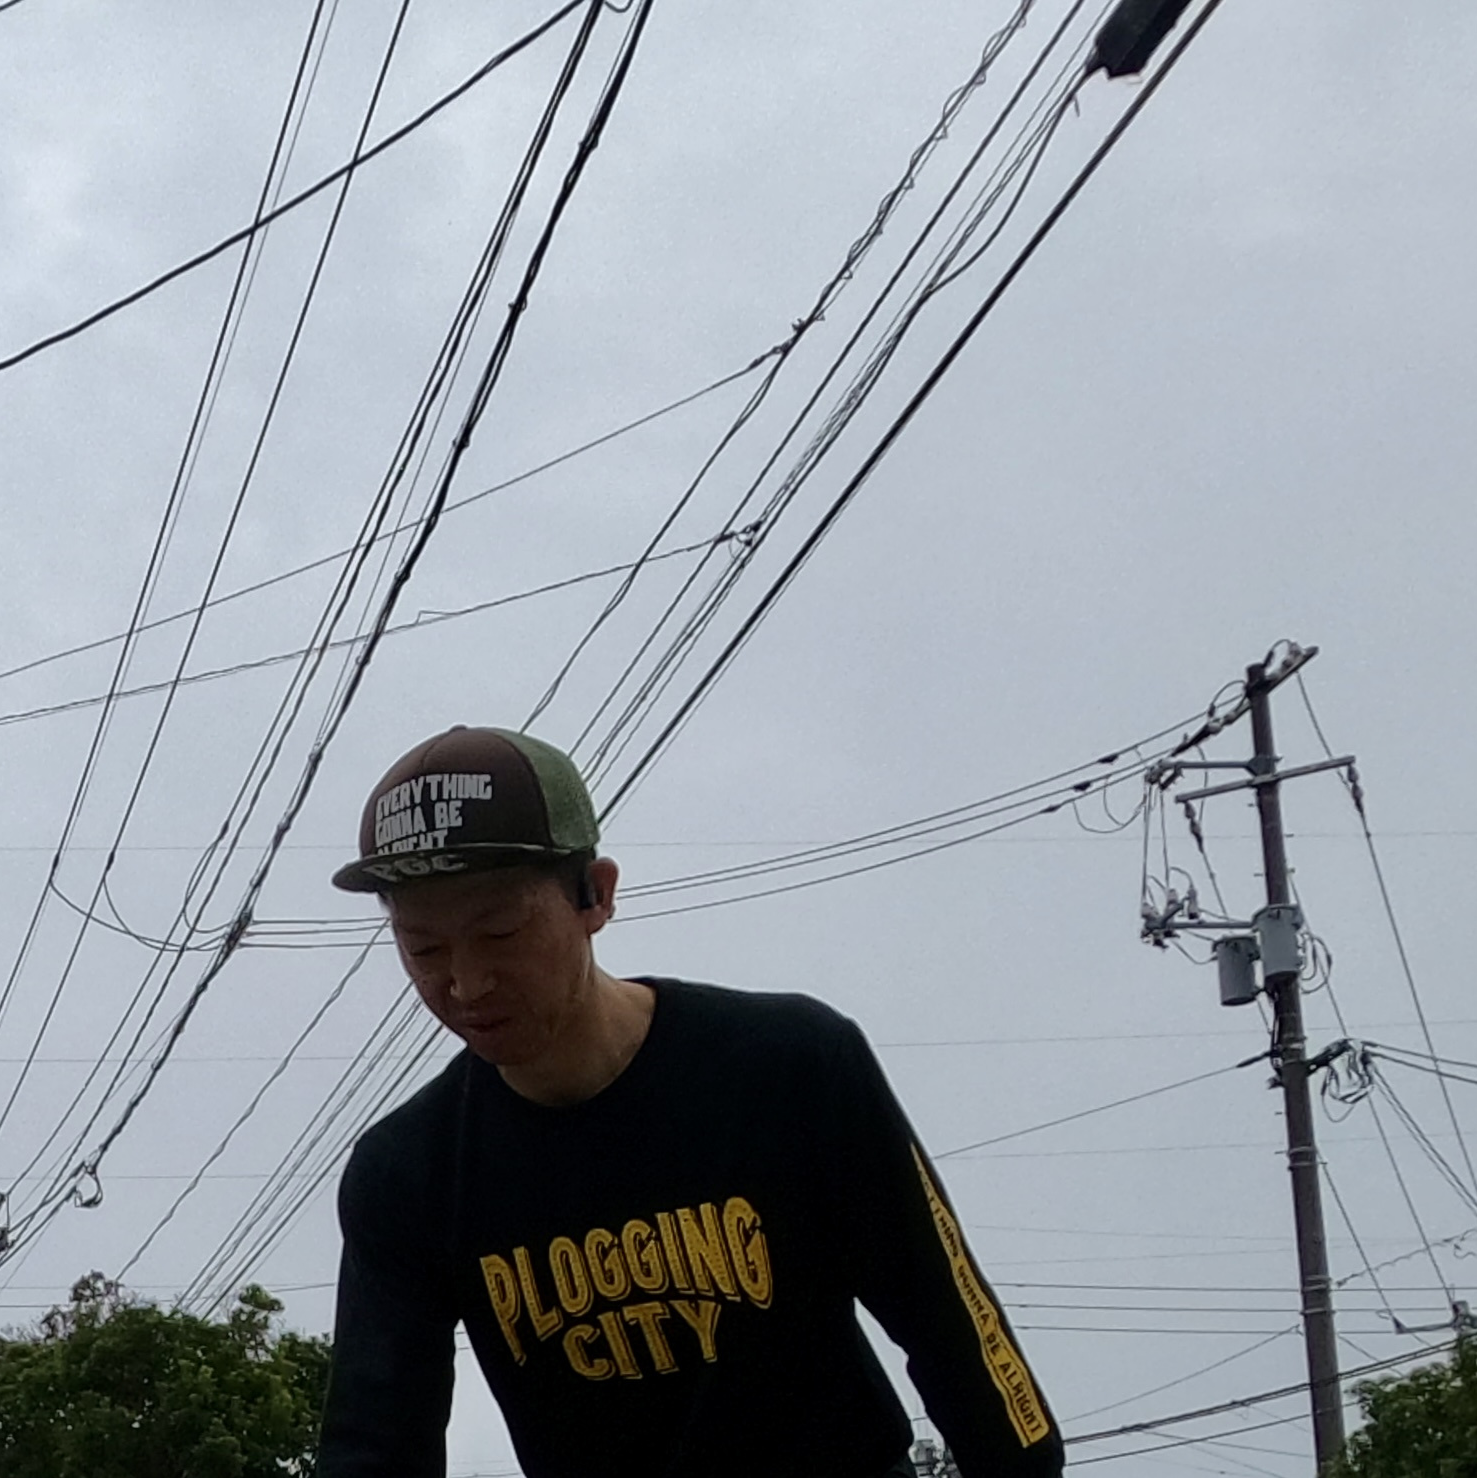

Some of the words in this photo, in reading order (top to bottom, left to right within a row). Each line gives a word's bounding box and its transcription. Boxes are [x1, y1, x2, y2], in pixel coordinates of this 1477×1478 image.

[375, 773, 493, 822] EVERYTHING
[375, 804, 427, 849] GONNA
[434, 800, 463, 829] BE
[479, 1196, 772, 1367] PLOGGING
[562, 1300, 722, 1381] CITY
[998, 1361, 1044, 1434] ALRIGHT
